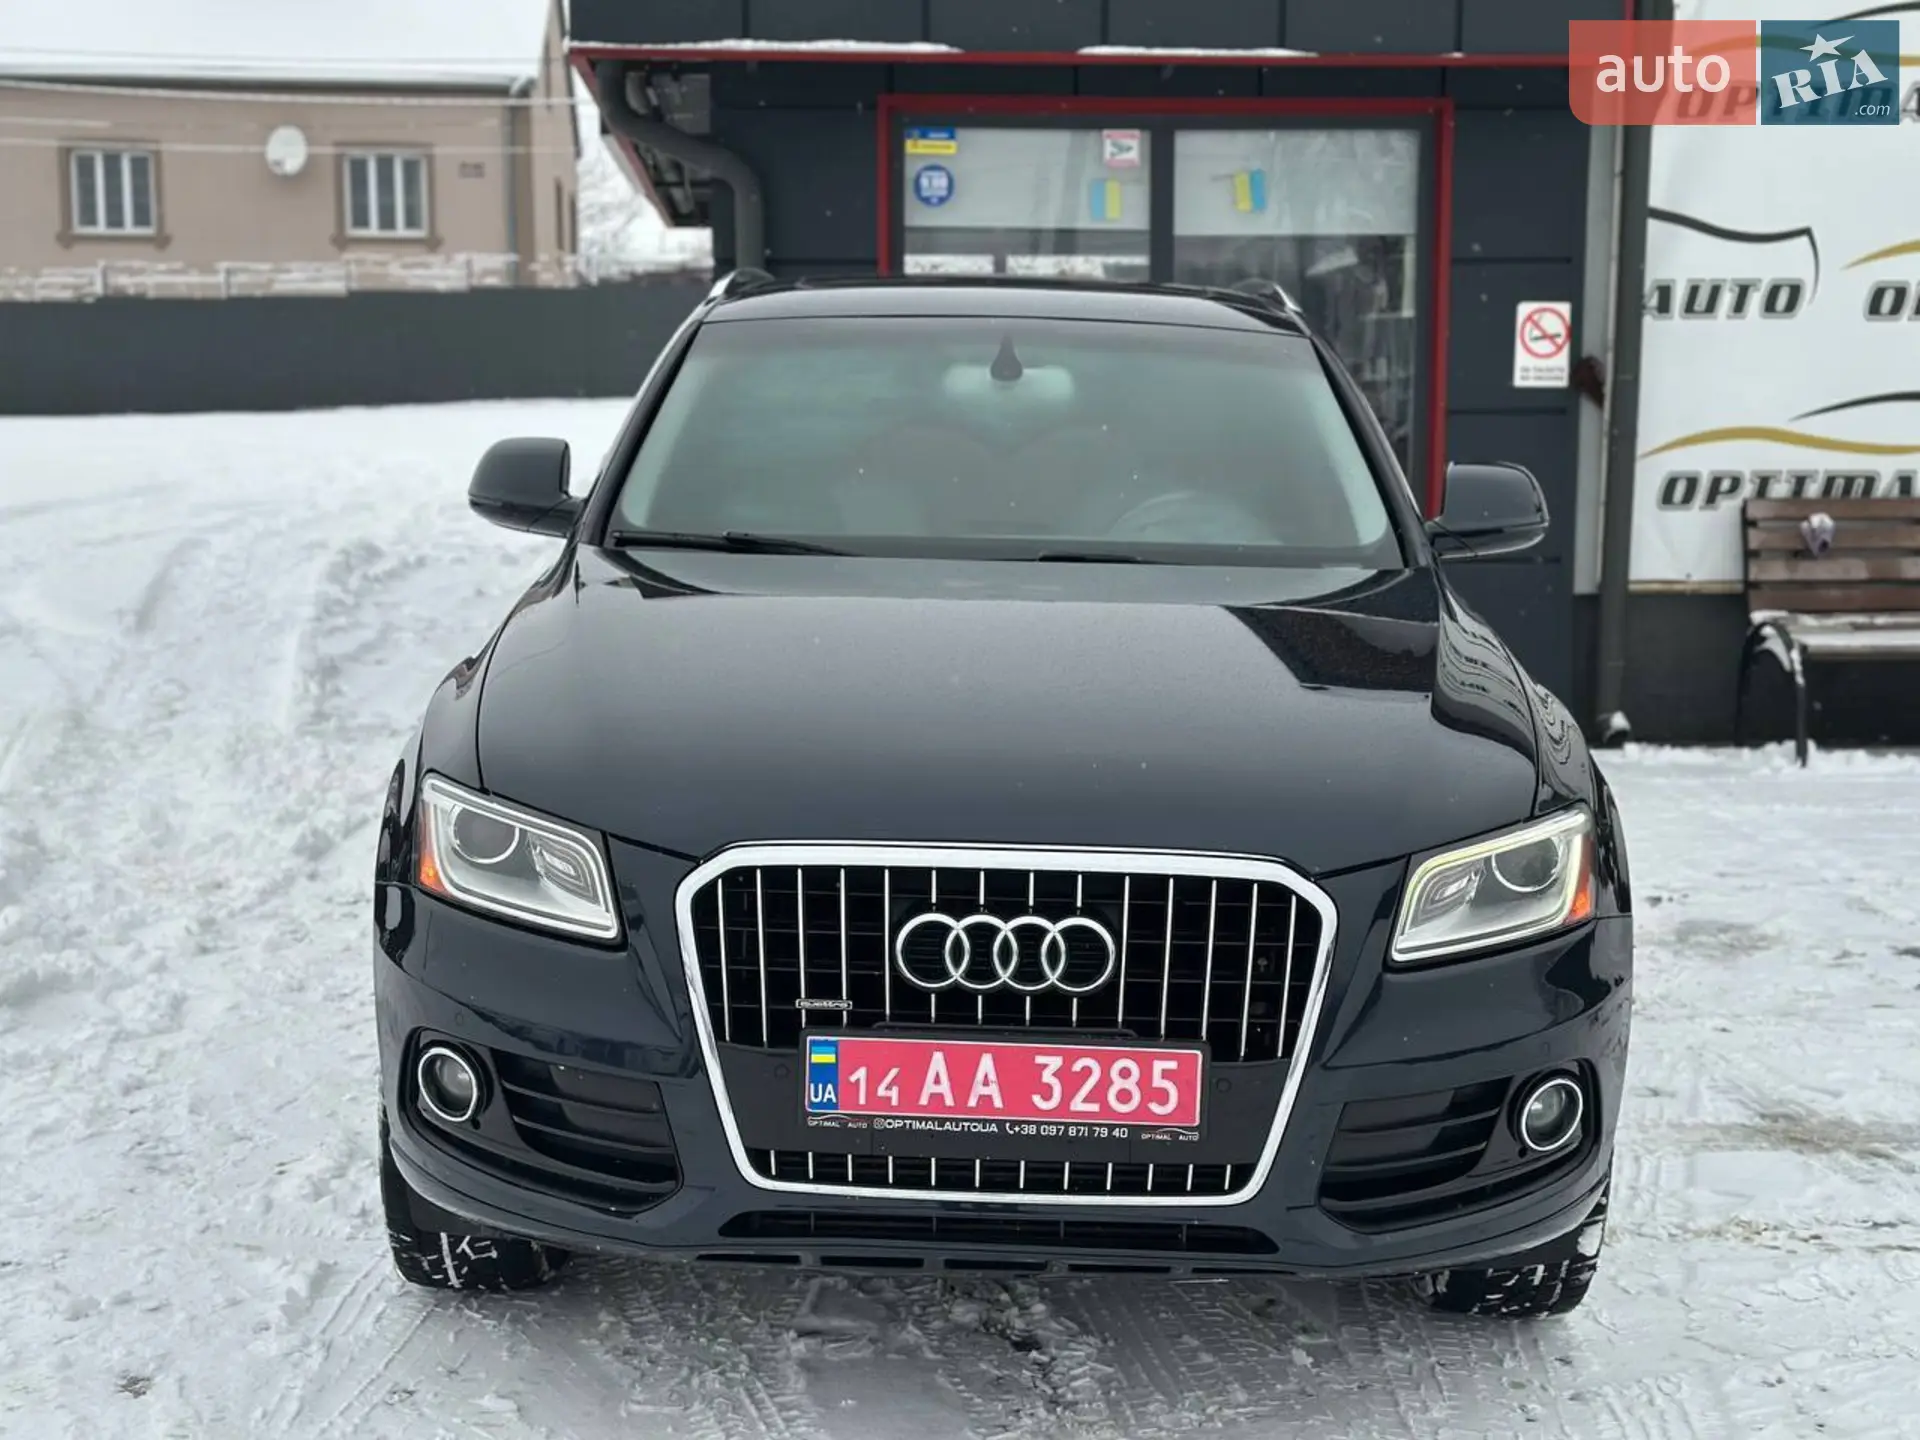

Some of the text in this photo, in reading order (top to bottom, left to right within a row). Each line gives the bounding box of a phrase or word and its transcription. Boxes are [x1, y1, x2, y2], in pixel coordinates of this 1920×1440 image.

[1645, 278, 1806, 320] AUTO
[1863, 280, 1920, 322] O
[809, 1083, 837, 1104] UA
[848, 1050, 1179, 1116] 14 AA 3285
[1013, 1124, 1037, 1135] +38
[1040, 1125, 1065, 1136] 097
[1068, 1126, 1088, 1137] 871
[1092, 1127, 1108, 1138] 79
[1112, 1127, 1128, 1138] 40
